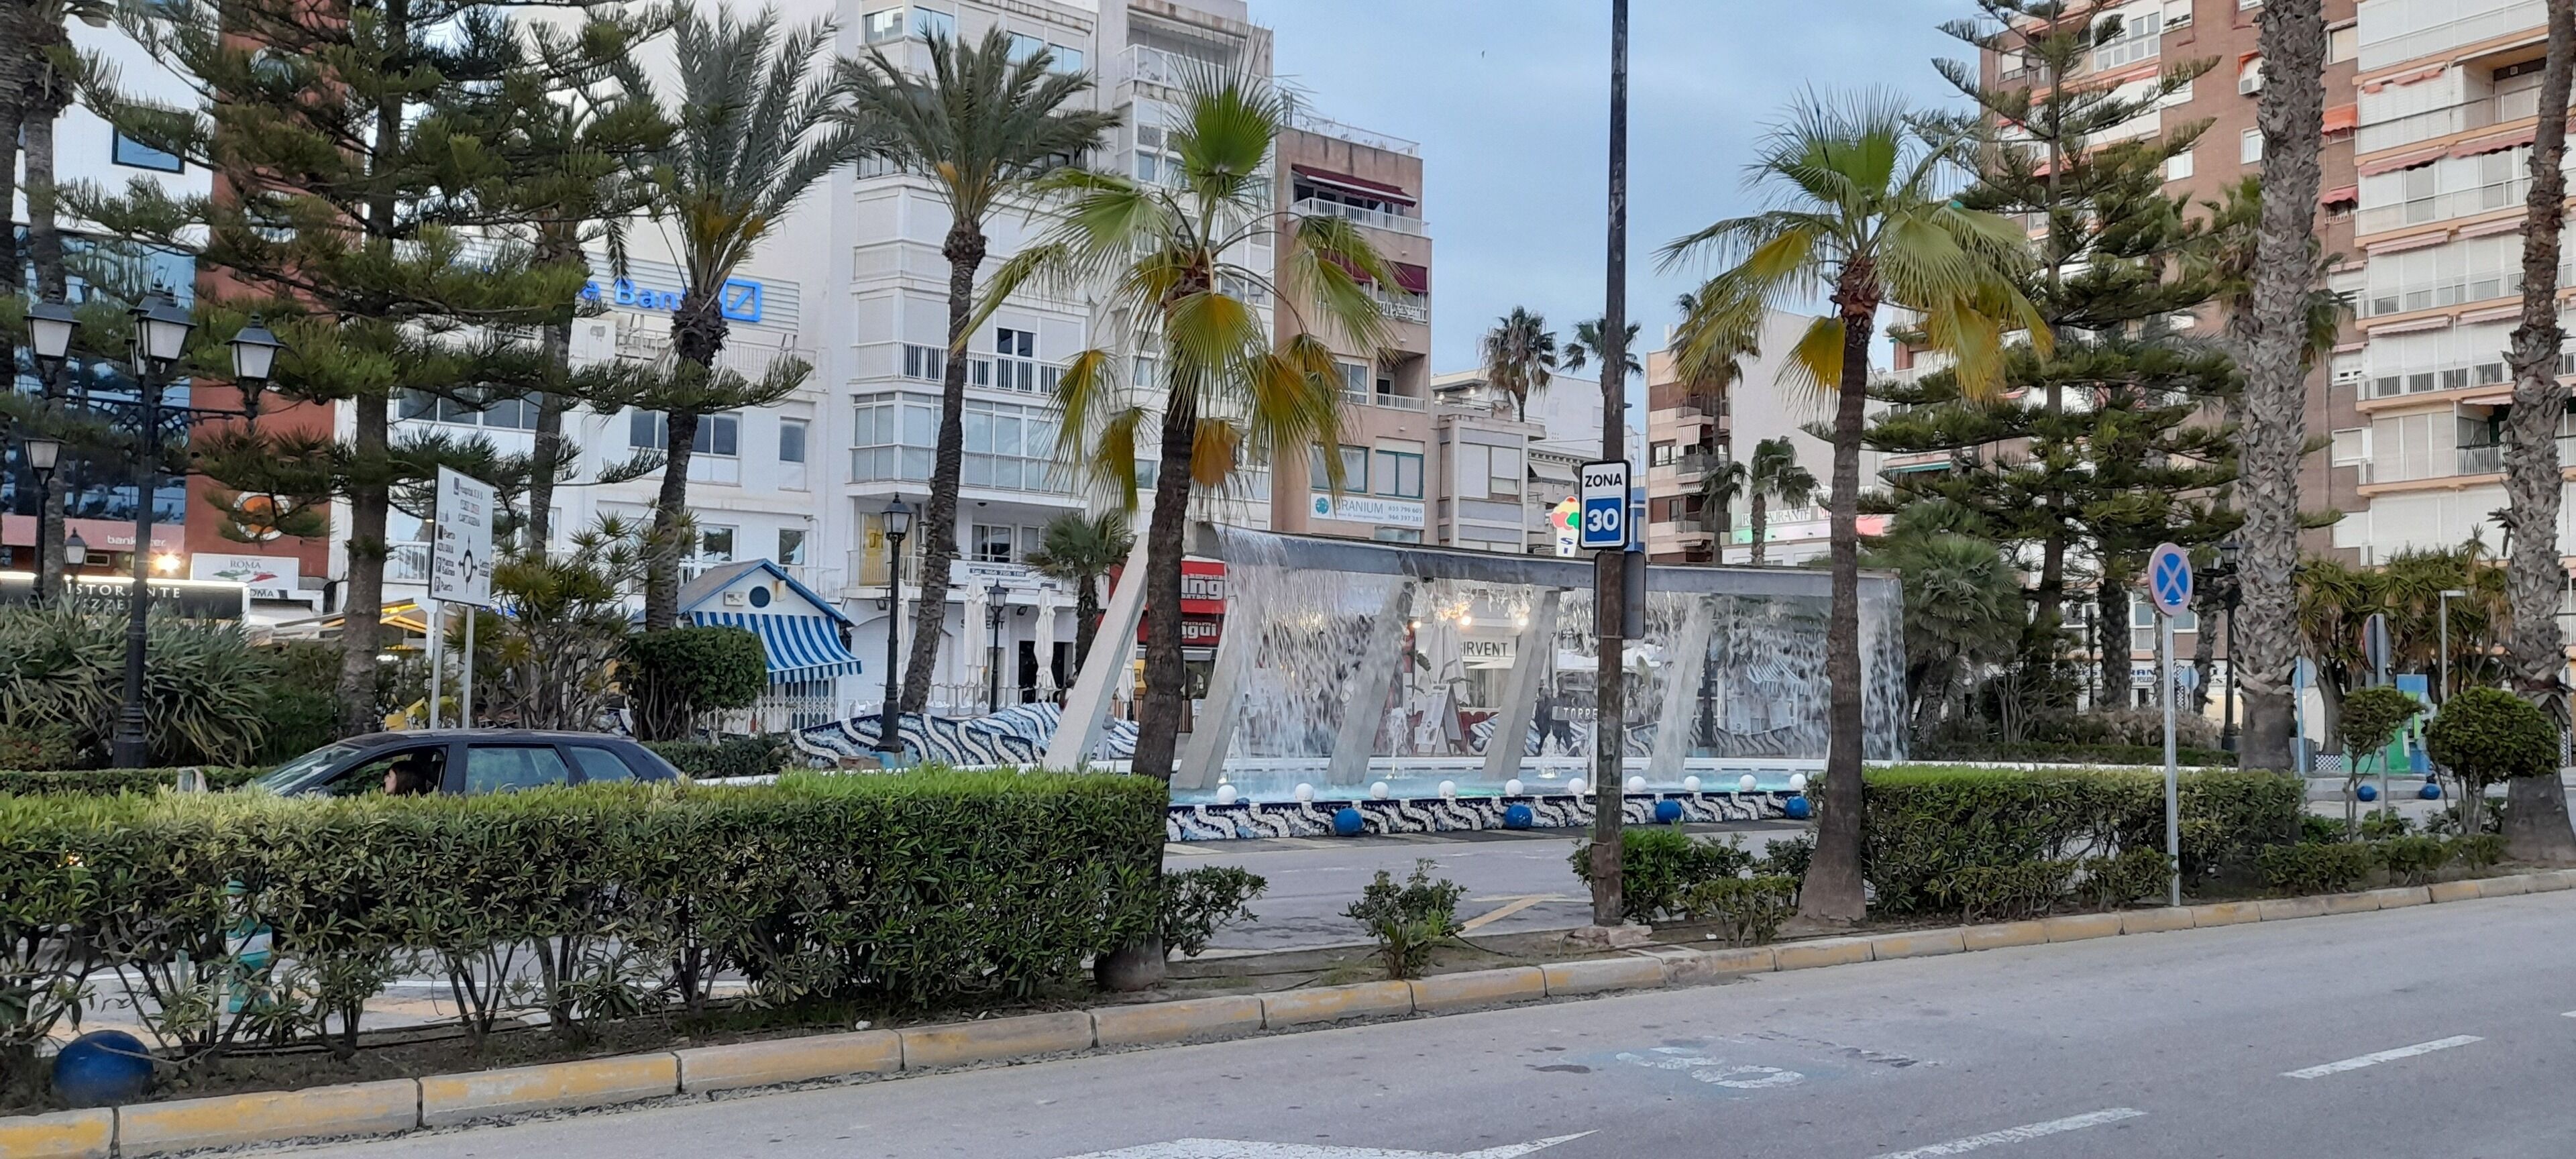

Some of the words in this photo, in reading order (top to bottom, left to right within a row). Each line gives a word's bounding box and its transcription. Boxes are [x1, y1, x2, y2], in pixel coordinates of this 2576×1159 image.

[614, 277, 684, 311] Ban
[1585, 474, 1622, 488] ZONA
[1587, 508, 1619, 532] 30
[230, 560, 261, 569] ROMA
[248, 589, 274, 598] OMA
